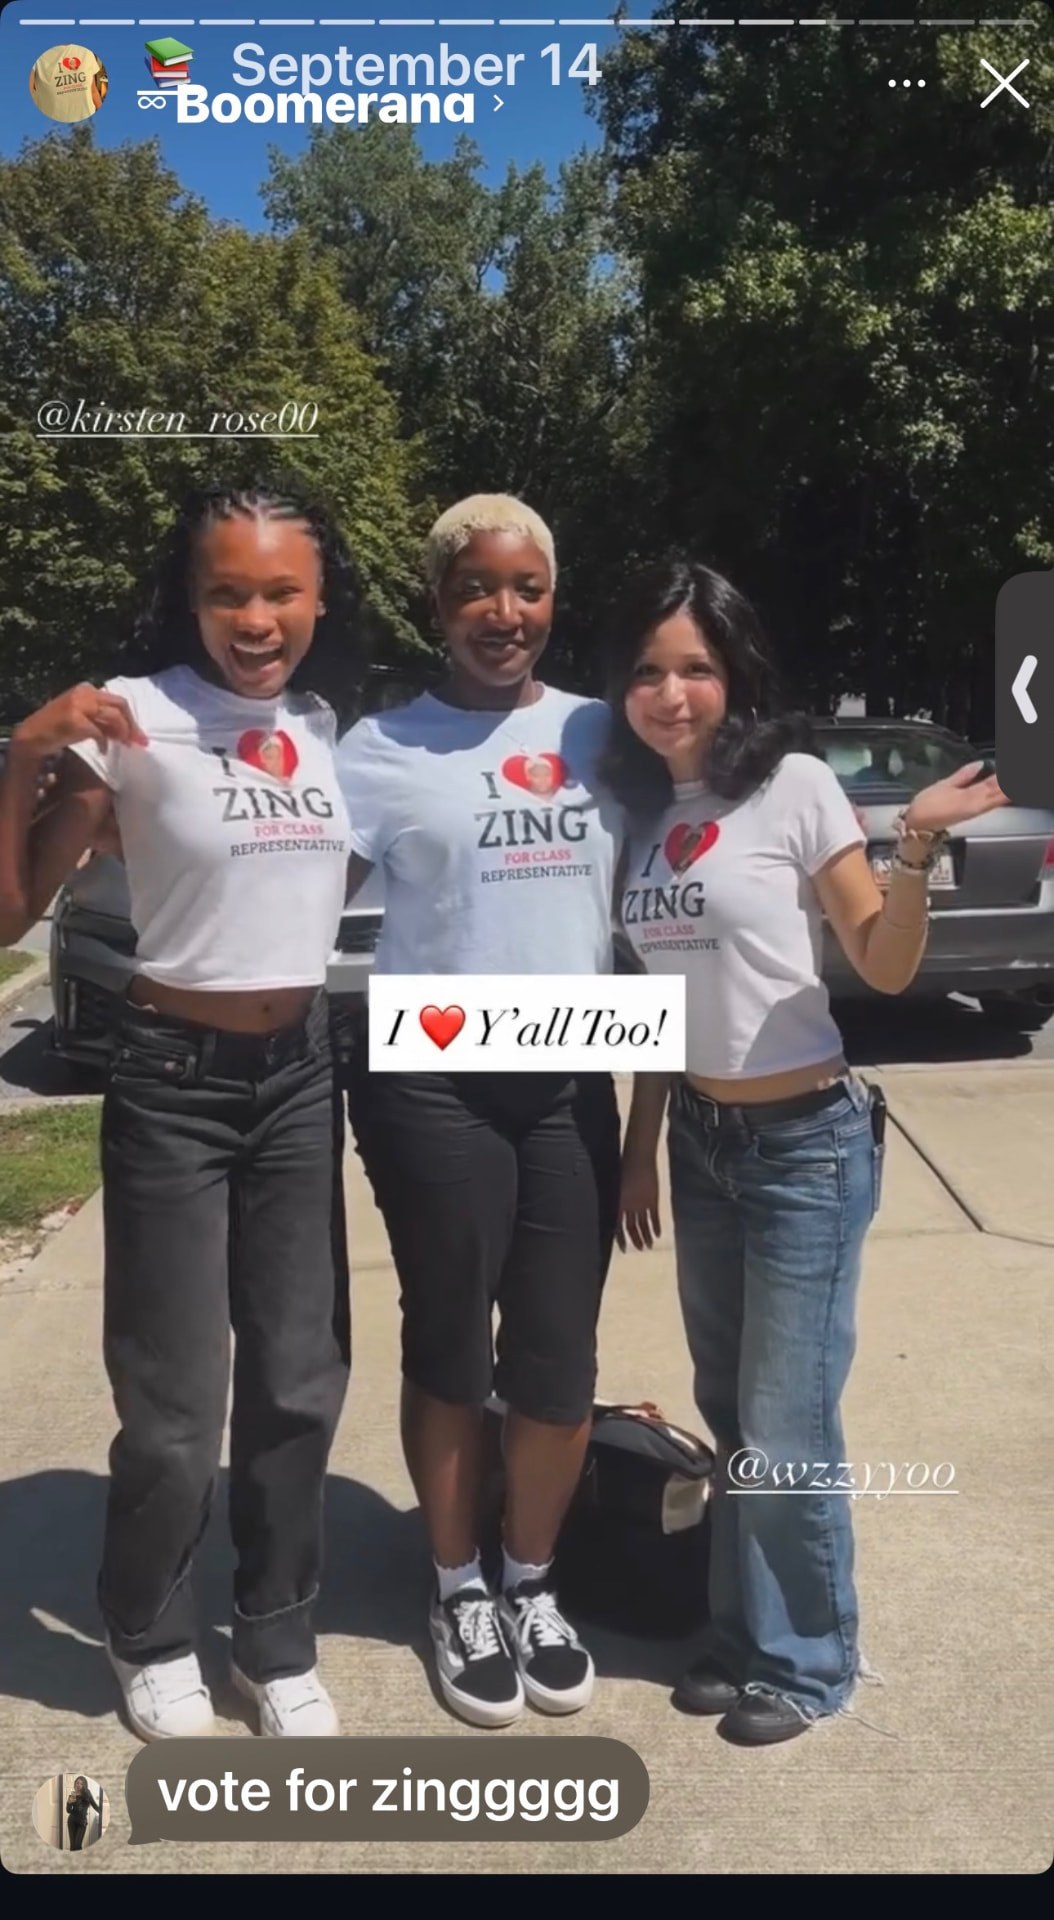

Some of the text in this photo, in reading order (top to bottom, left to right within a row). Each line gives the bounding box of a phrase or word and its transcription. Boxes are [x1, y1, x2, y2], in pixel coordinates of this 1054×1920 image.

[54, 72, 87, 87] ZING
[480, 771, 502, 799] I
[212, 787, 334, 822] ZING
[254, 823, 324, 837] FOR CLASS
[473, 805, 588, 848] ZING
[230, 839, 346, 856] REPRESENTATIVE
[504, 849, 572, 865] FOR CLASS
[641, 844, 661, 877] I
[480, 864, 592, 883] REPRESENTATIVE
[625, 882, 705, 924] ZING
[665, 924, 696, 937] CLASS
